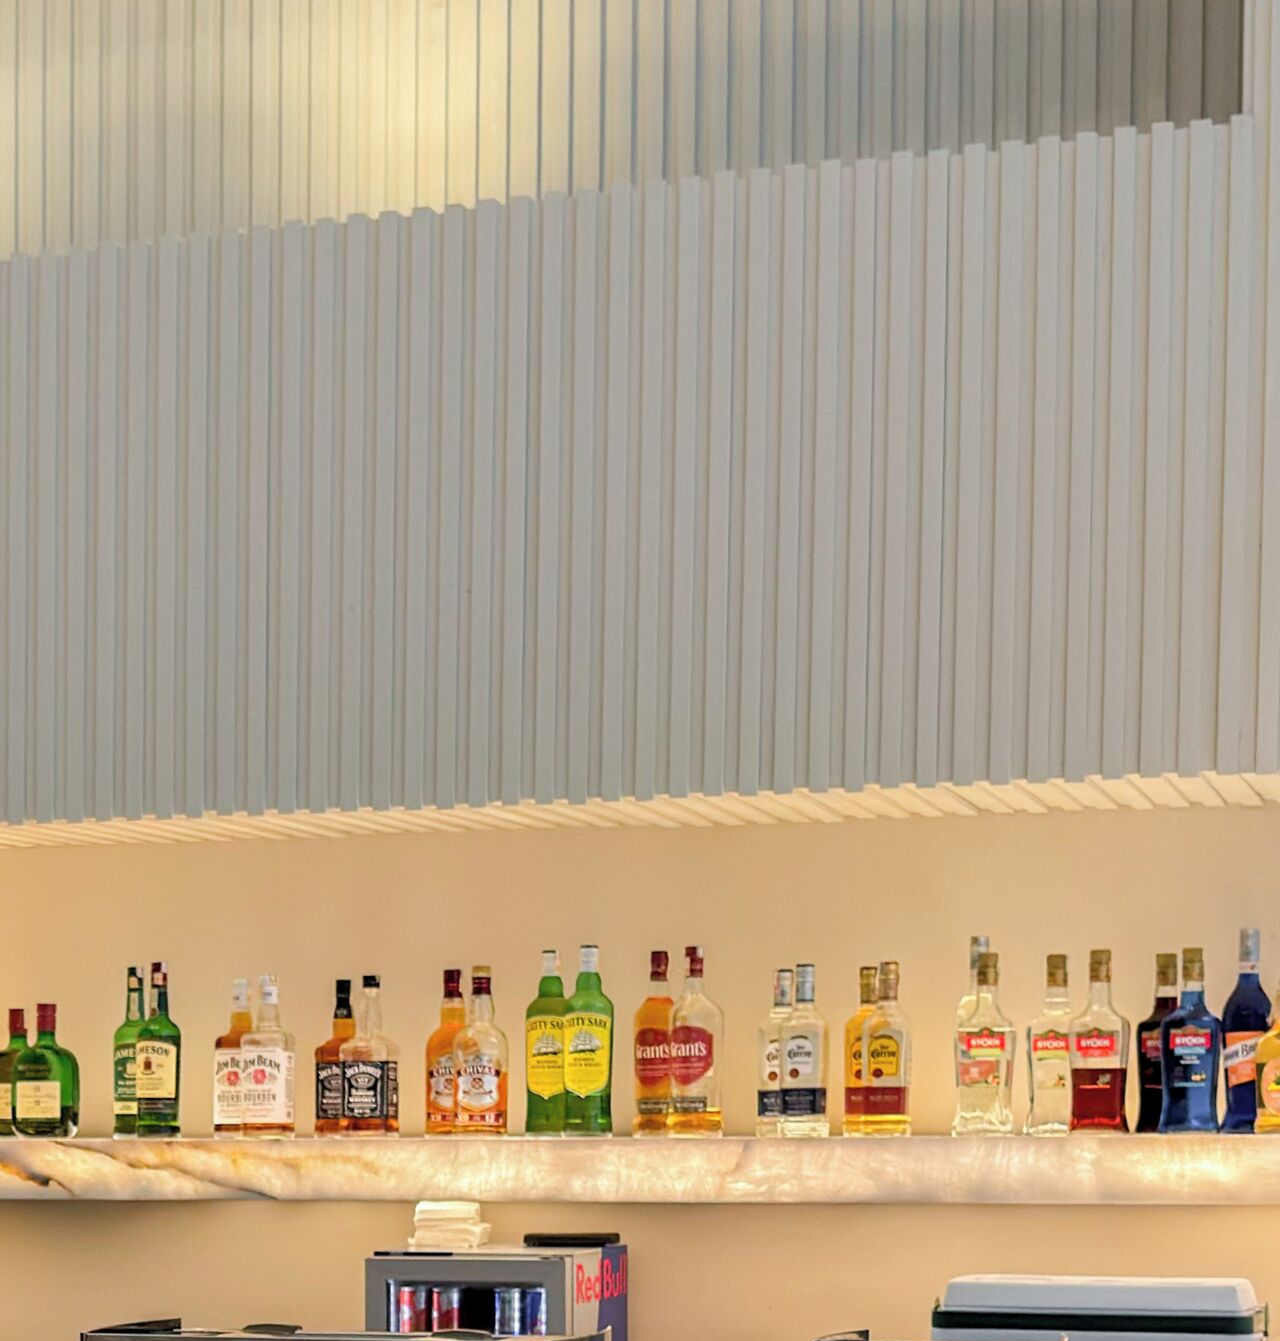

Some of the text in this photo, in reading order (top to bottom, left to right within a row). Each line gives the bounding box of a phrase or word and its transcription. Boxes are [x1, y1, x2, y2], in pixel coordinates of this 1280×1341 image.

[460, 1065, 496, 1076] CHIVAS
[576, 1253, 627, 1305] Red Bull
